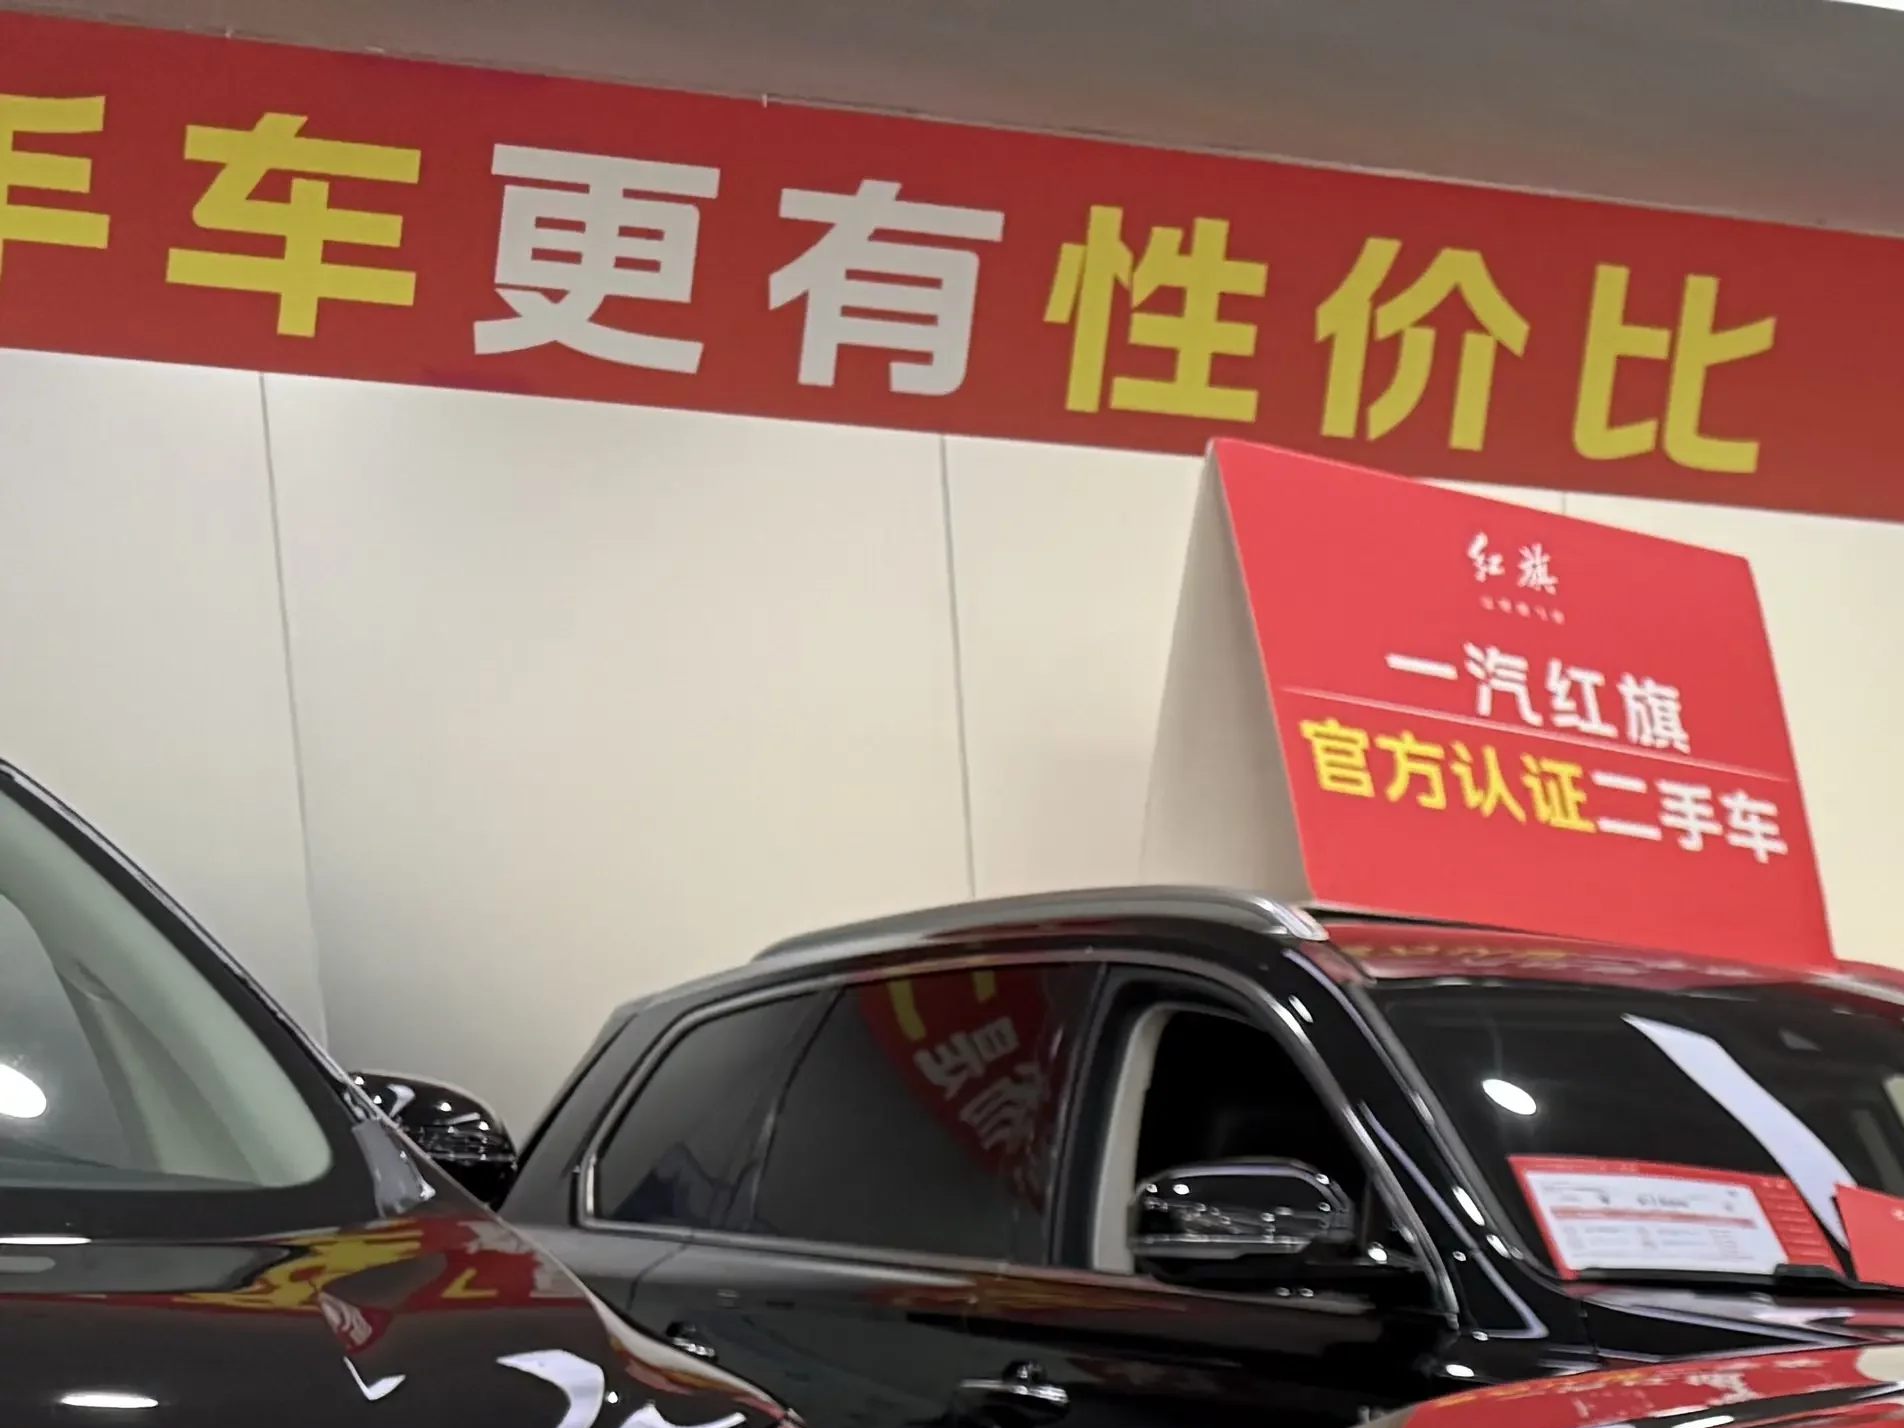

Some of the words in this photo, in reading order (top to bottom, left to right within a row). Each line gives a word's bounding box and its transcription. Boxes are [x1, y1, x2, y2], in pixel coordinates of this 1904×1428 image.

[1467, 530, 1559, 595] 红旗
[1384, 642, 1691, 753] 一汽红旗
[1299, 716, 1788, 863] 官方认证二手车
